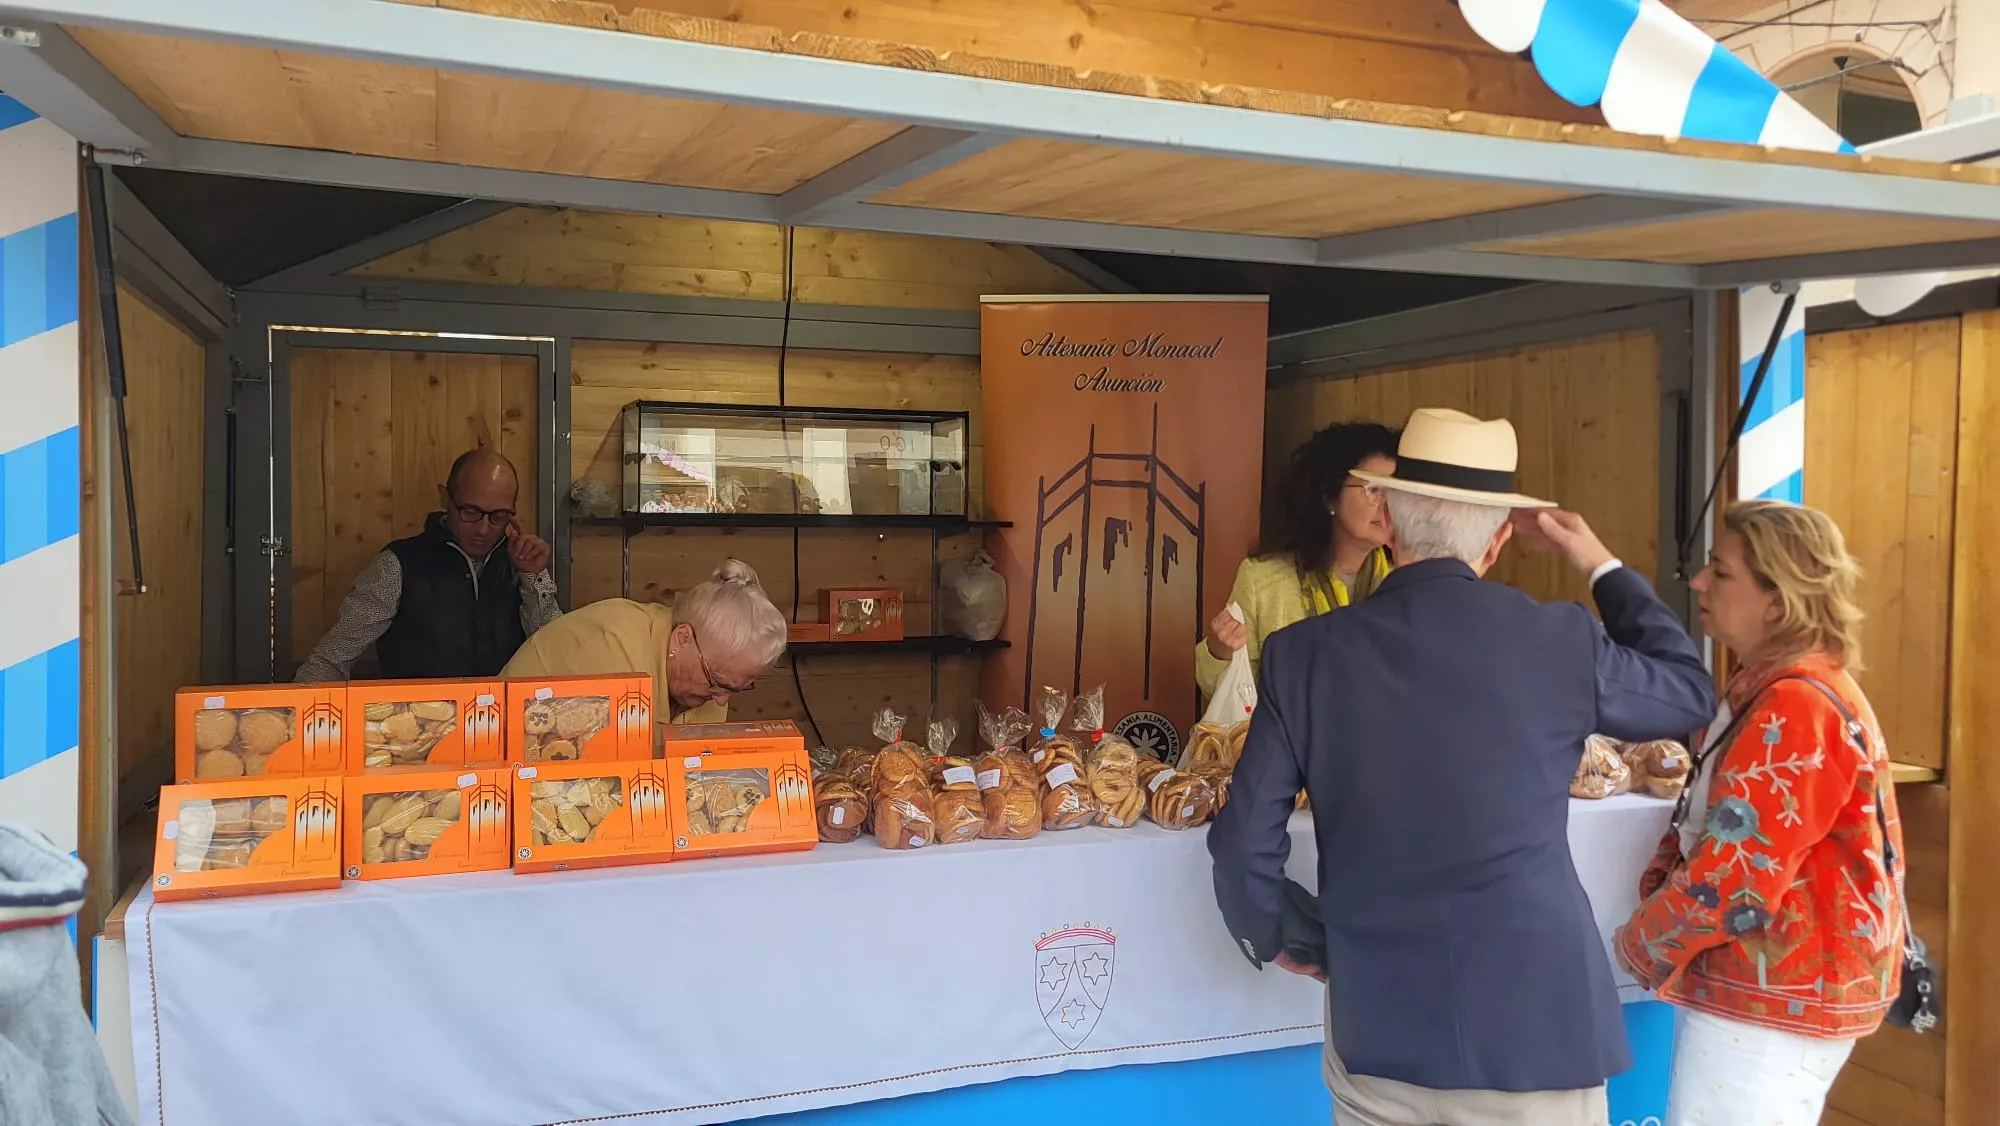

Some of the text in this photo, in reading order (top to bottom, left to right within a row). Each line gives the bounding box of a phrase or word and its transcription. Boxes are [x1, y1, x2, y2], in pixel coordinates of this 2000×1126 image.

[1020, 331, 1225, 358] Artesanía Monacal
[1073, 366, 1166, 392] Asunción
